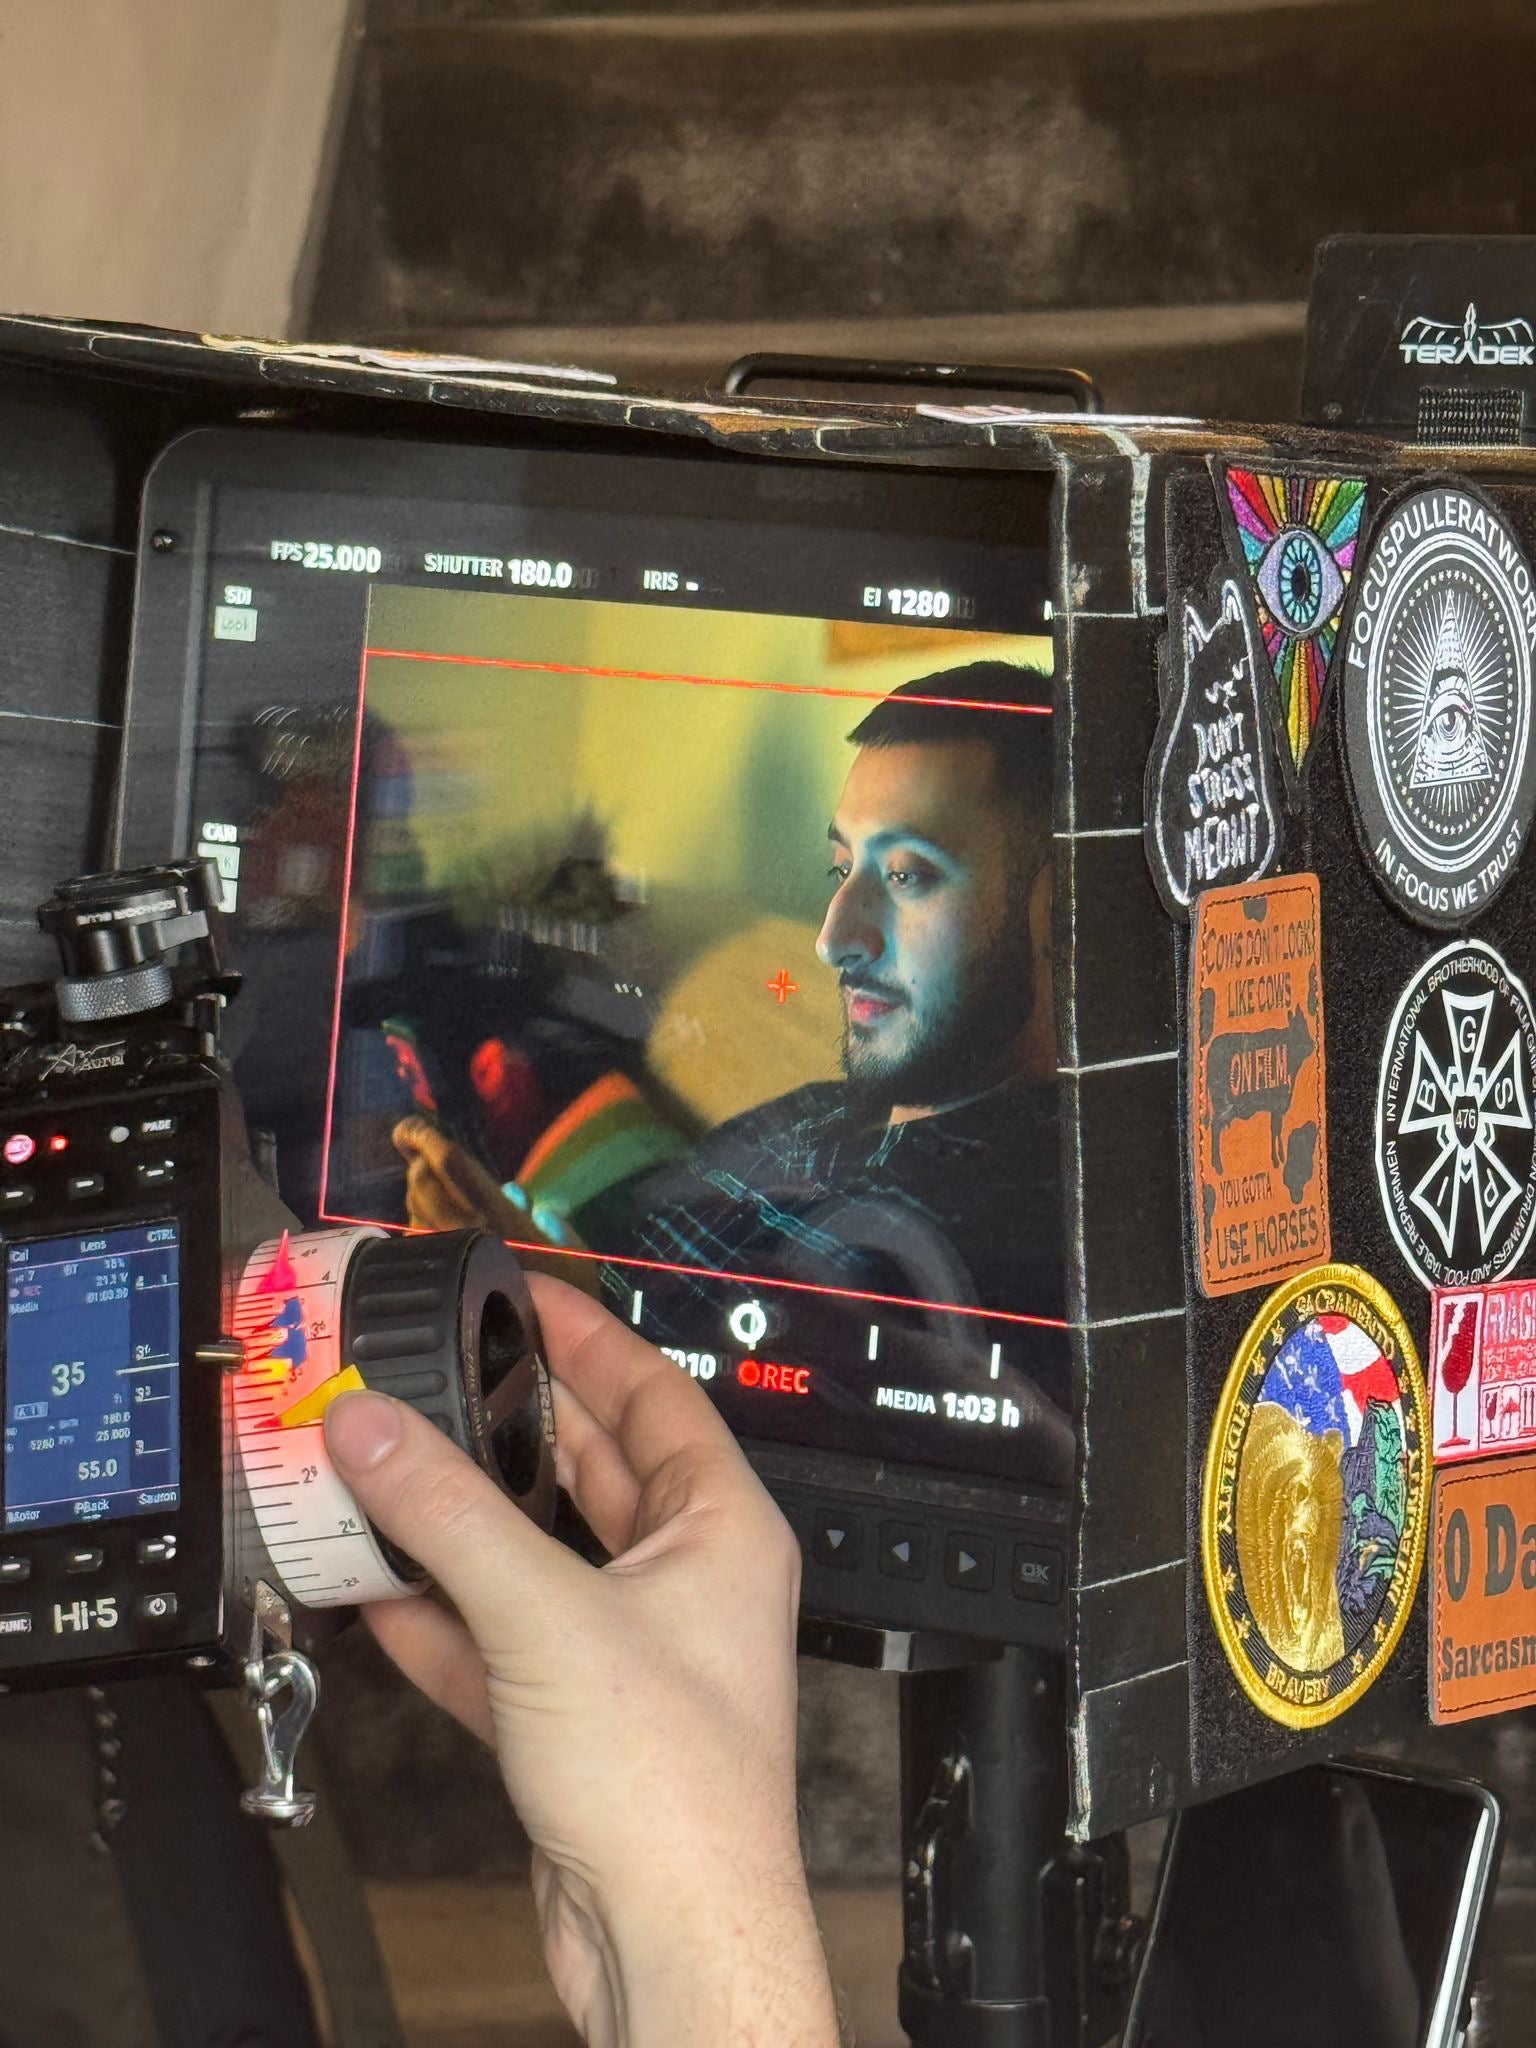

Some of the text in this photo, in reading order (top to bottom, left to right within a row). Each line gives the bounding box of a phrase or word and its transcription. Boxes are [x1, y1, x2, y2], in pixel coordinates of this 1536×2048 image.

[1399, 340, 1535, 365] TERADEK
[270, 540, 382, 573] FPS 25.000
[424, 553, 573, 588] SHUTTER 180.0
[224, 585, 252, 605] SDI
[643, 570, 678, 591] IRIS
[863, 586, 950, 618] EI 1280
[1184, 803, 1260, 884] MEOWT
[1375, 819, 1521, 911] IN FOCUS WE TRUST
[1203, 928, 1244, 974] COWS
[1228, 972, 1291, 1018] LIKE COWS
[1386, 989, 1428, 1122] INTERNATIONAL
[1427, 956, 1499, 992] BROTHERHOOD
[1459, 1016, 1476, 1053] G
[1230, 1051, 1251, 1096] ON
[1455, 1109, 1476, 1130] 476
[1220, 1172, 1272, 1208] YOU GOTTA
[1386, 1140, 1420, 1246] REPAIRMEN
[147, 1229, 176, 1242] CTRL
[1216, 1205, 1318, 1269] USE HORSES
[1415, 1239, 1442, 1280] TABLE
[1444, 1266, 1469, 1286] POOL
[1471, 1260, 1494, 1284] AND
[1296, 1288, 1395, 1360] SACRAMENTO
[761, 1362, 811, 1394] REC
[876, 1387, 1020, 1428] MEDIA 1:03 h
[78, 1459, 118, 1480] 55.0
[1216, 1401, 1250, 1536] FIDELITY
[1387, 1449, 1422, 1604] INTEGRITY
[1021, 1562, 1050, 1585] OK
[53, 1597, 119, 1634] Hi-5
[1265, 1661, 1330, 1704] BRAVERY
